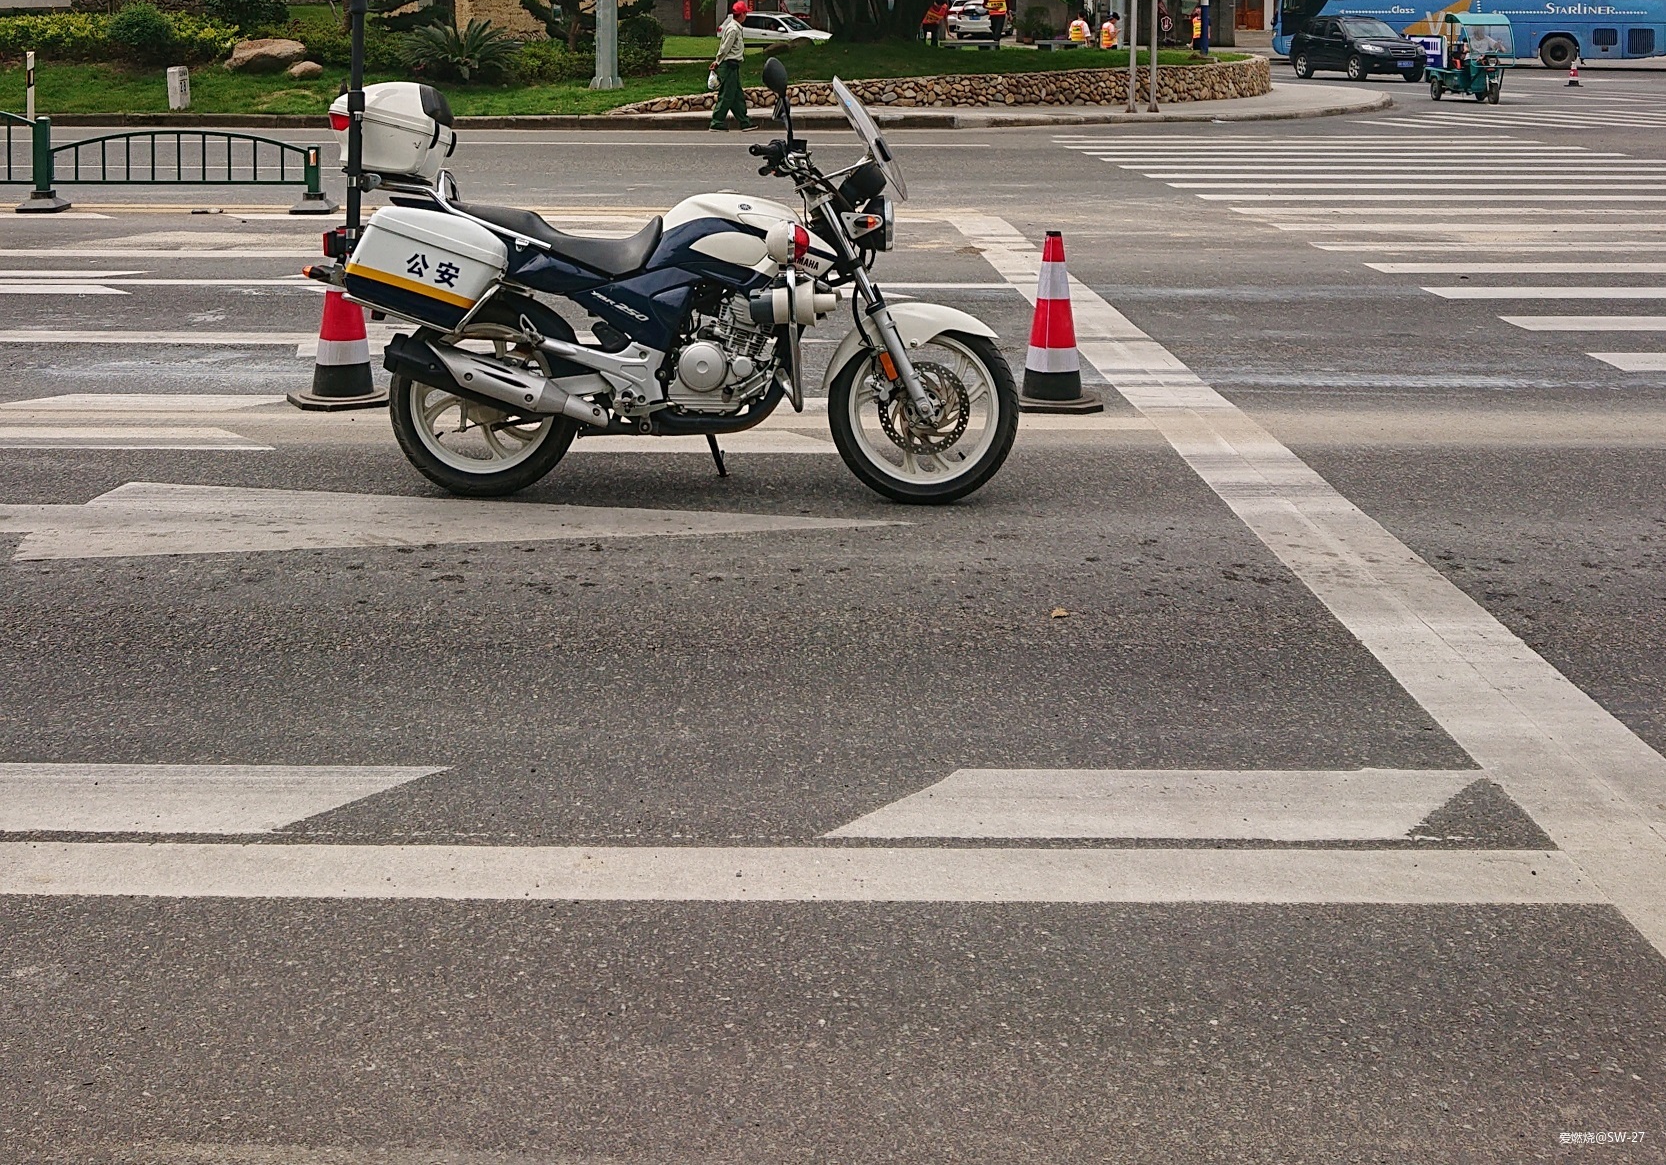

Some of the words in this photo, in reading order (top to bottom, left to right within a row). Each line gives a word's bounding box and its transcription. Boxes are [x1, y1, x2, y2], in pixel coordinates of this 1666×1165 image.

[1391, 5, 1415, 14] Class
[406, 253, 460, 288] 公安
[796, 256, 820, 271] MAHA
[613, 302, 650, 321] 250
